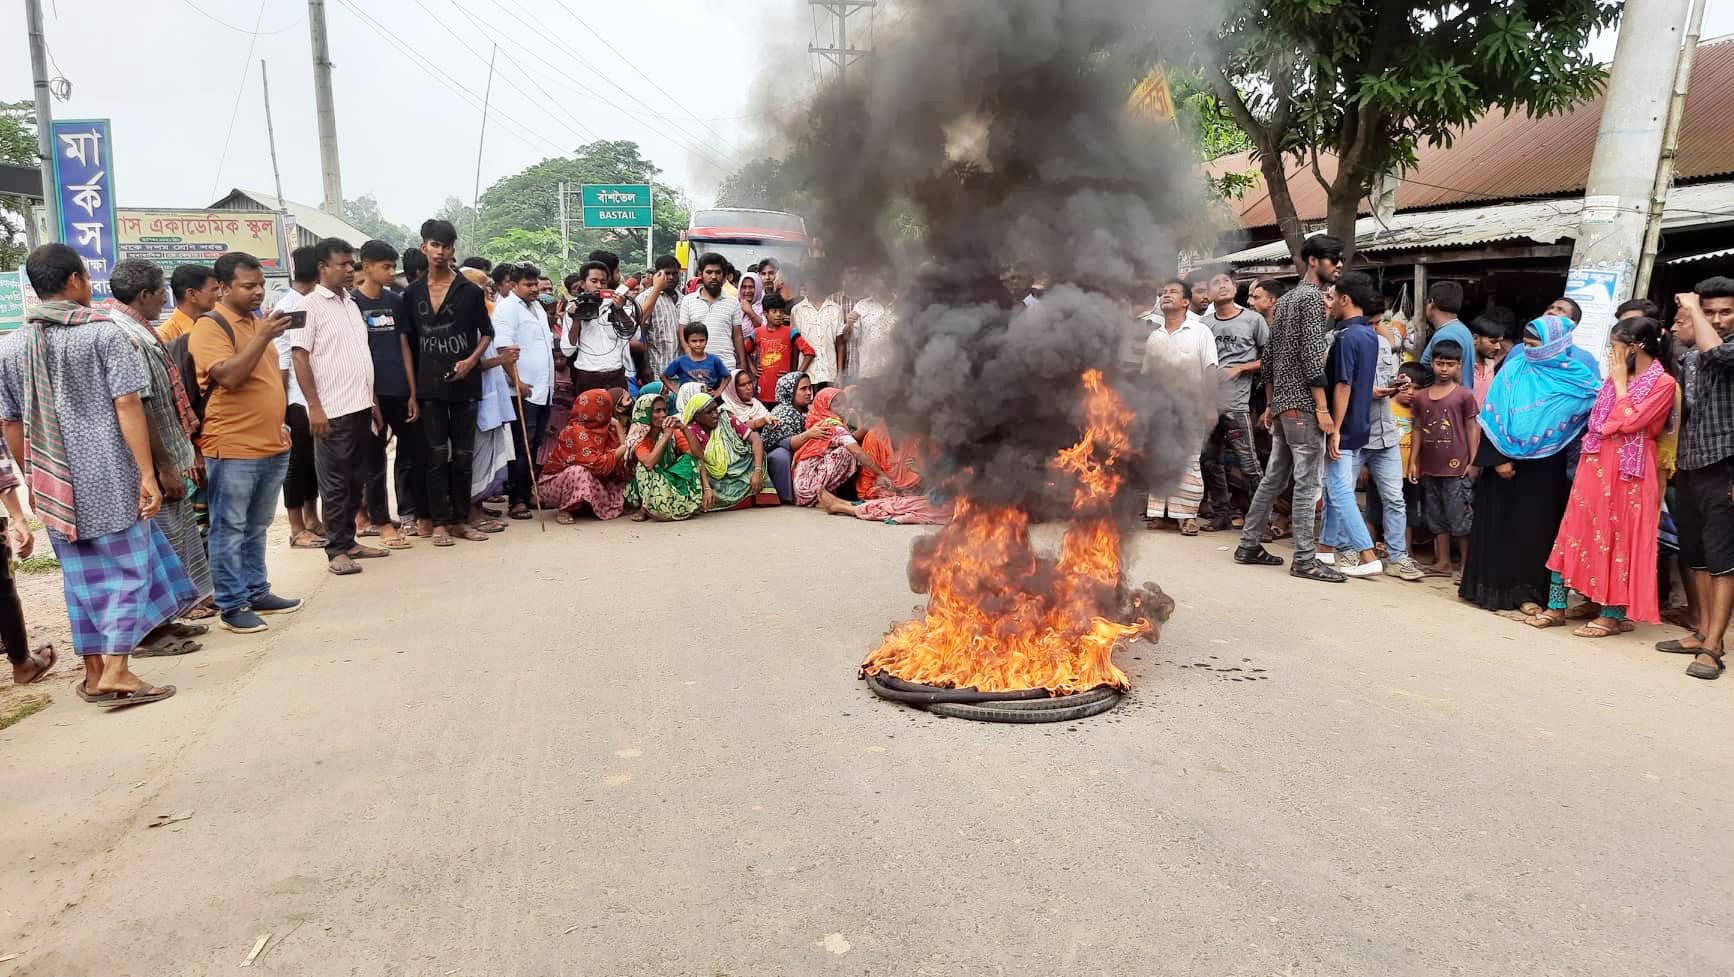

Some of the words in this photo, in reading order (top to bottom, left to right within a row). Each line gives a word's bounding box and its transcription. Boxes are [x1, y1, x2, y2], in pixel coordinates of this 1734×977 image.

[58, 128, 104, 255] মার্কস
[597, 189, 637, 204] বাঁশতৈল
[599, 210, 637, 220] BASTAIL
[117, 216, 141, 235] াস
[150, 213, 239, 235] একাডেমিক
[246, 219, 275, 240] স্কুল
